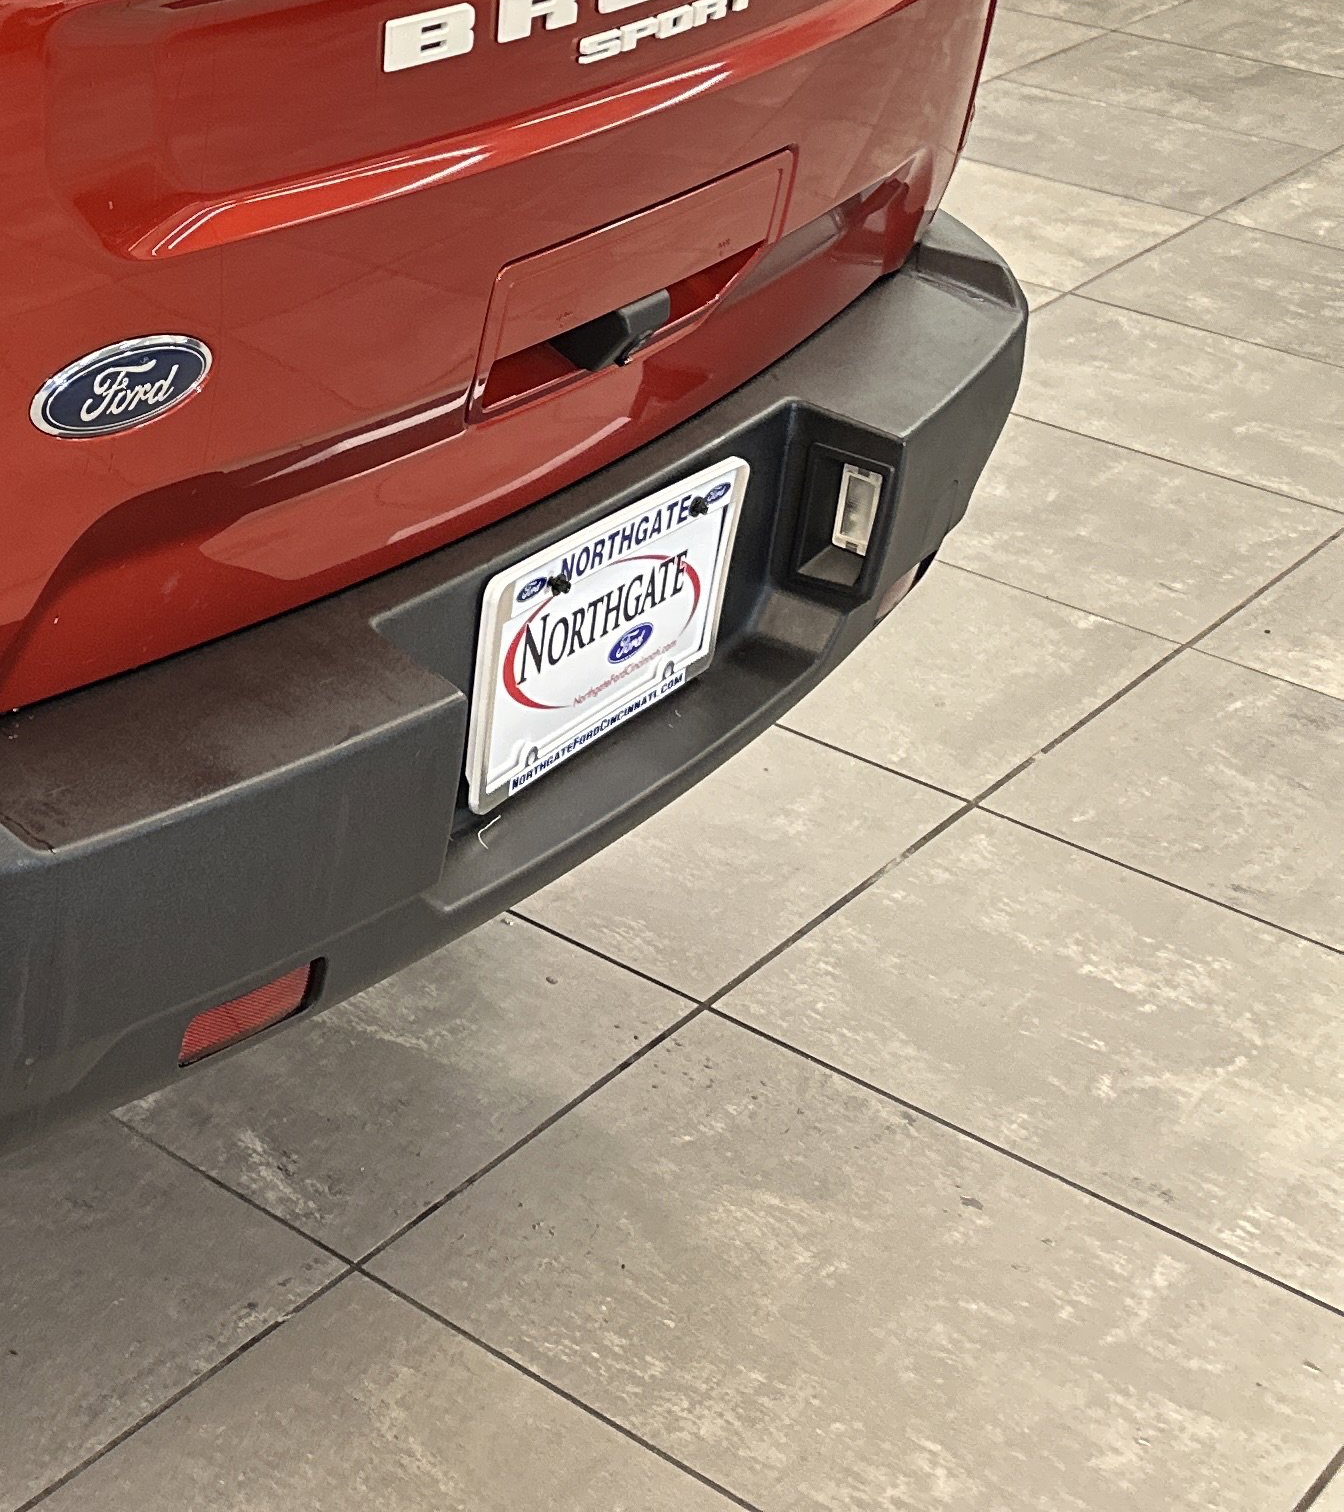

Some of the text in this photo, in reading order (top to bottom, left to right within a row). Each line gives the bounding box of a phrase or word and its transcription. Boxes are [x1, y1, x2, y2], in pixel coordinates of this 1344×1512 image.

[79, 359, 179, 422] Ford
[560, 494, 692, 583] NORTHGATE
[516, 549, 689, 685] NORTHGATE
[615, 629, 647, 657] Ford
